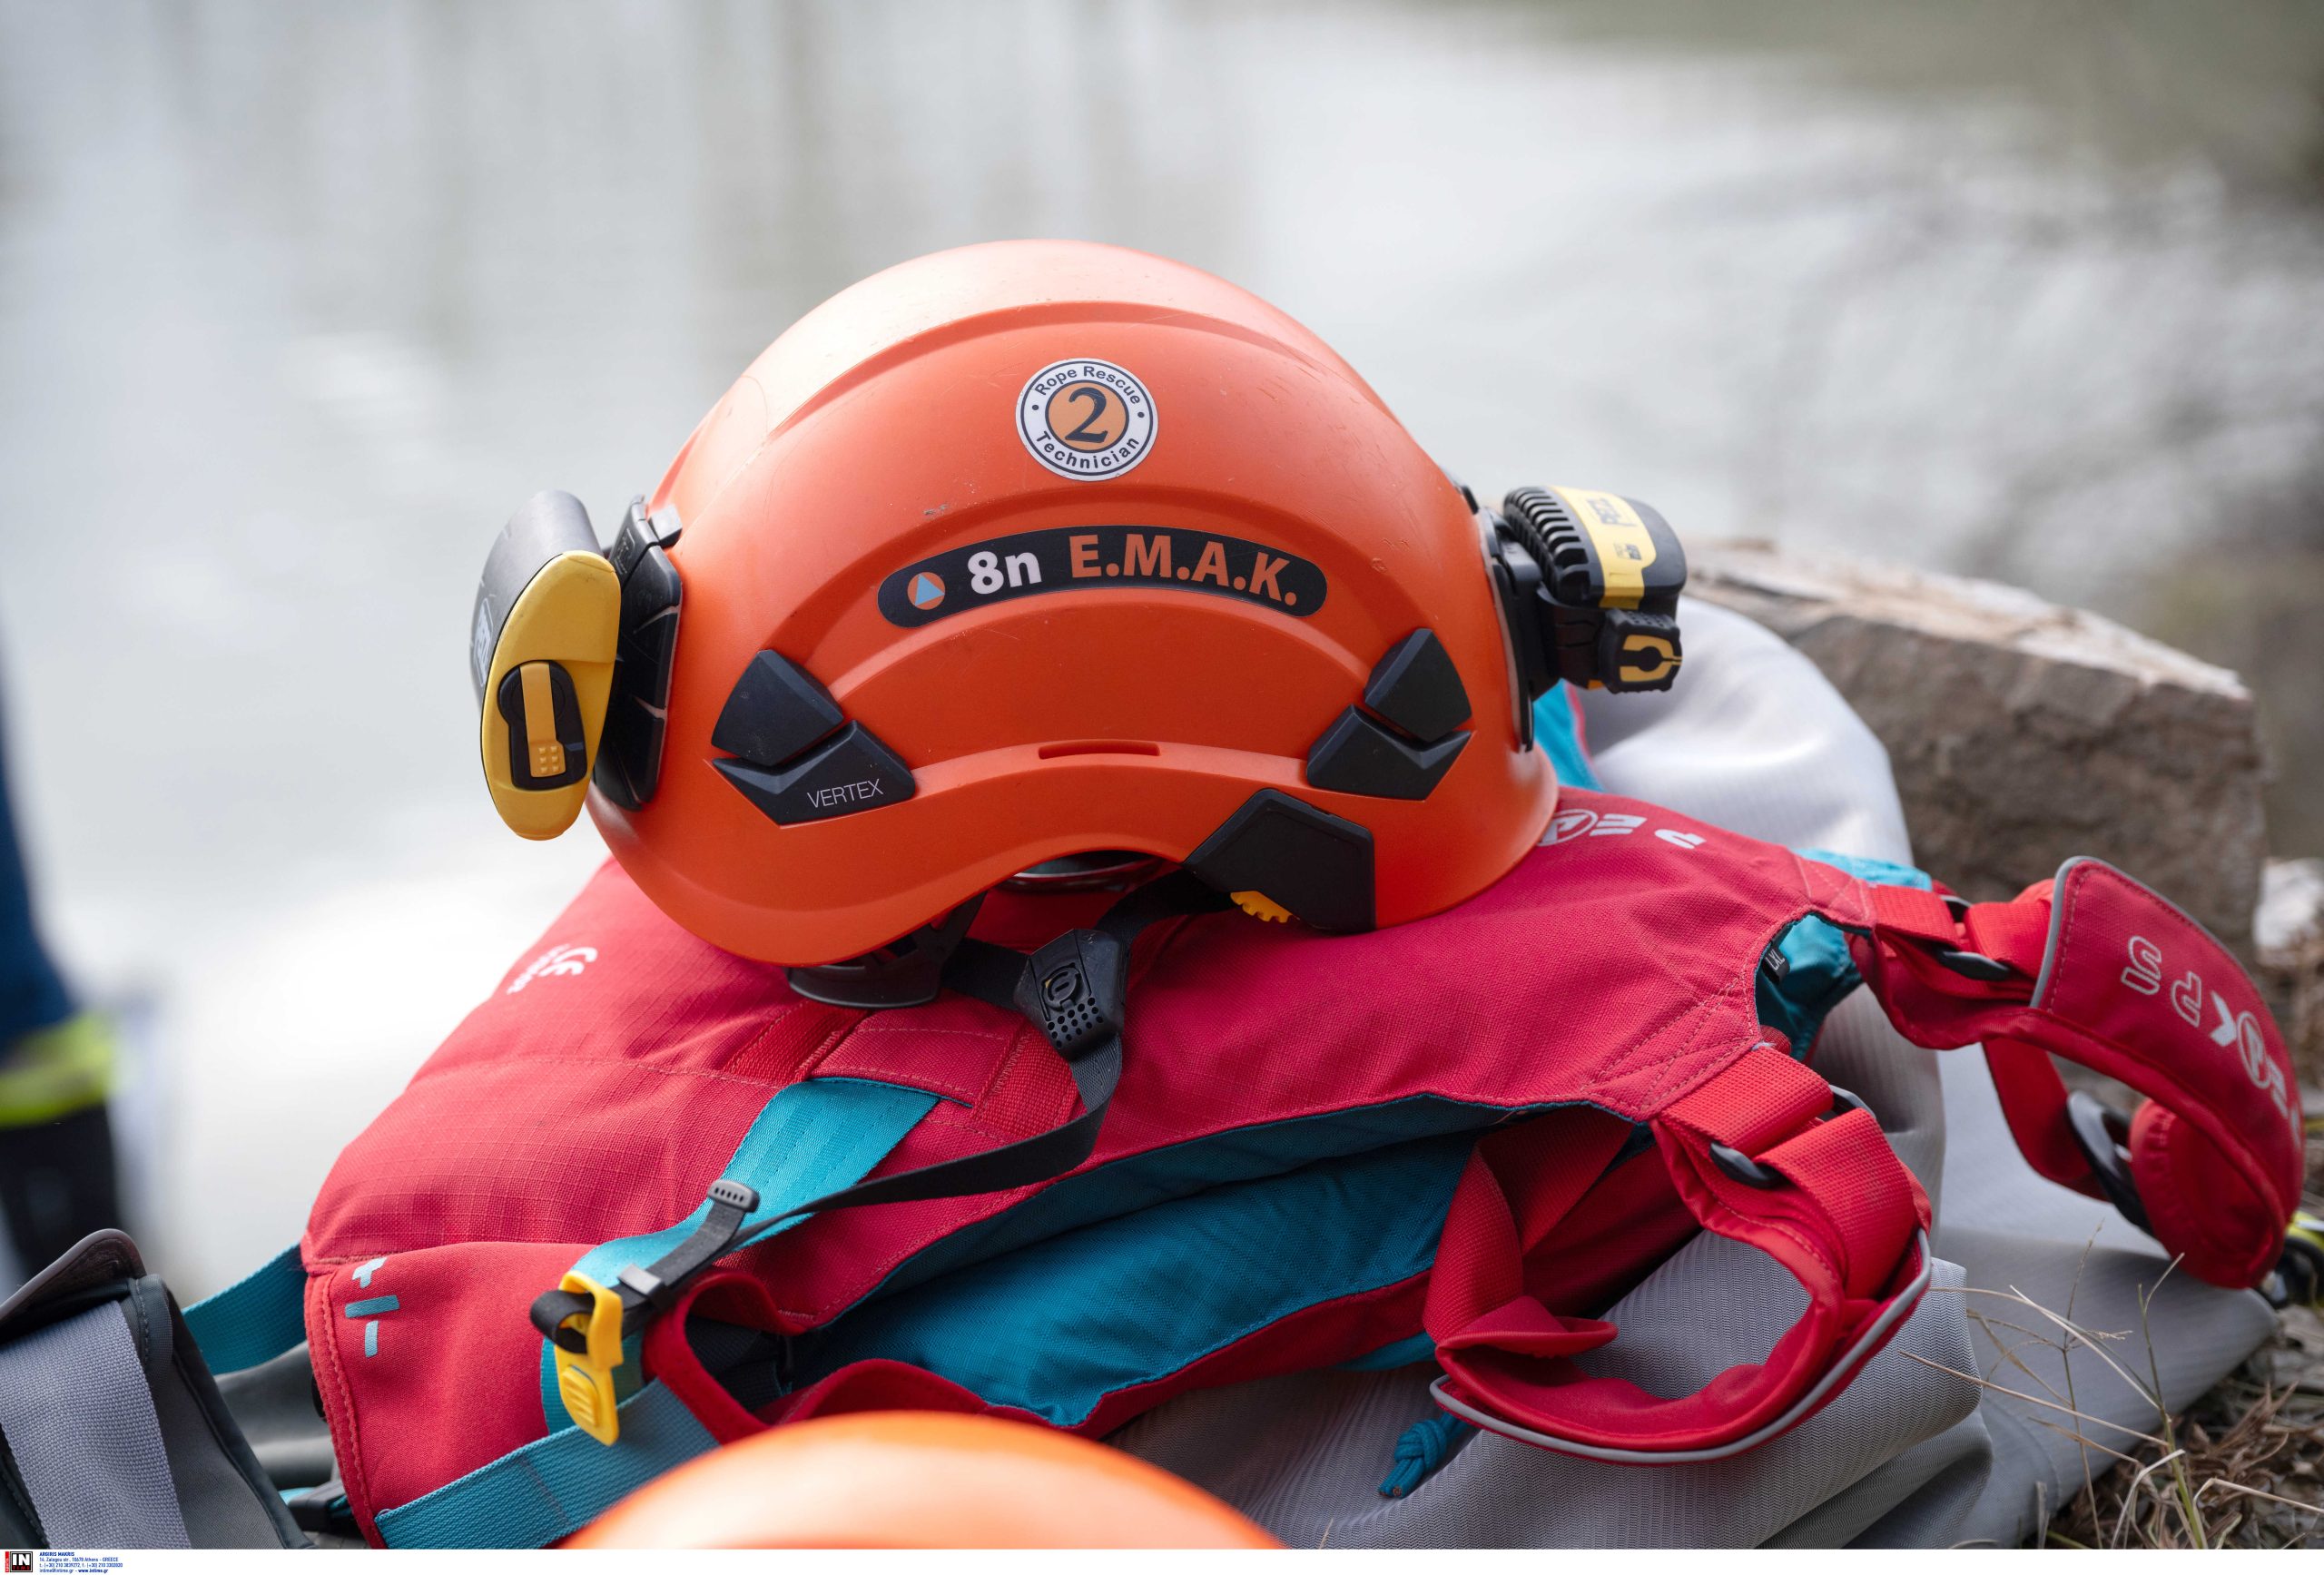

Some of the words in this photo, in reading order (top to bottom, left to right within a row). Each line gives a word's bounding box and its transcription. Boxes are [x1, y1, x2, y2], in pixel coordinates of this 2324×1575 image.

[1034, 368, 1078, 396] Rope
[1083, 366, 1141, 405] Rescue
[1065, 387, 1108, 444] 2
[1036, 430, 1140, 469] Technician
[966, 550, 1043, 596] 8n
[1068, 533, 1297, 606] E.M.A.K.
[806, 778, 884, 809] VERTEX
[1536, 807, 1707, 850] PEA
